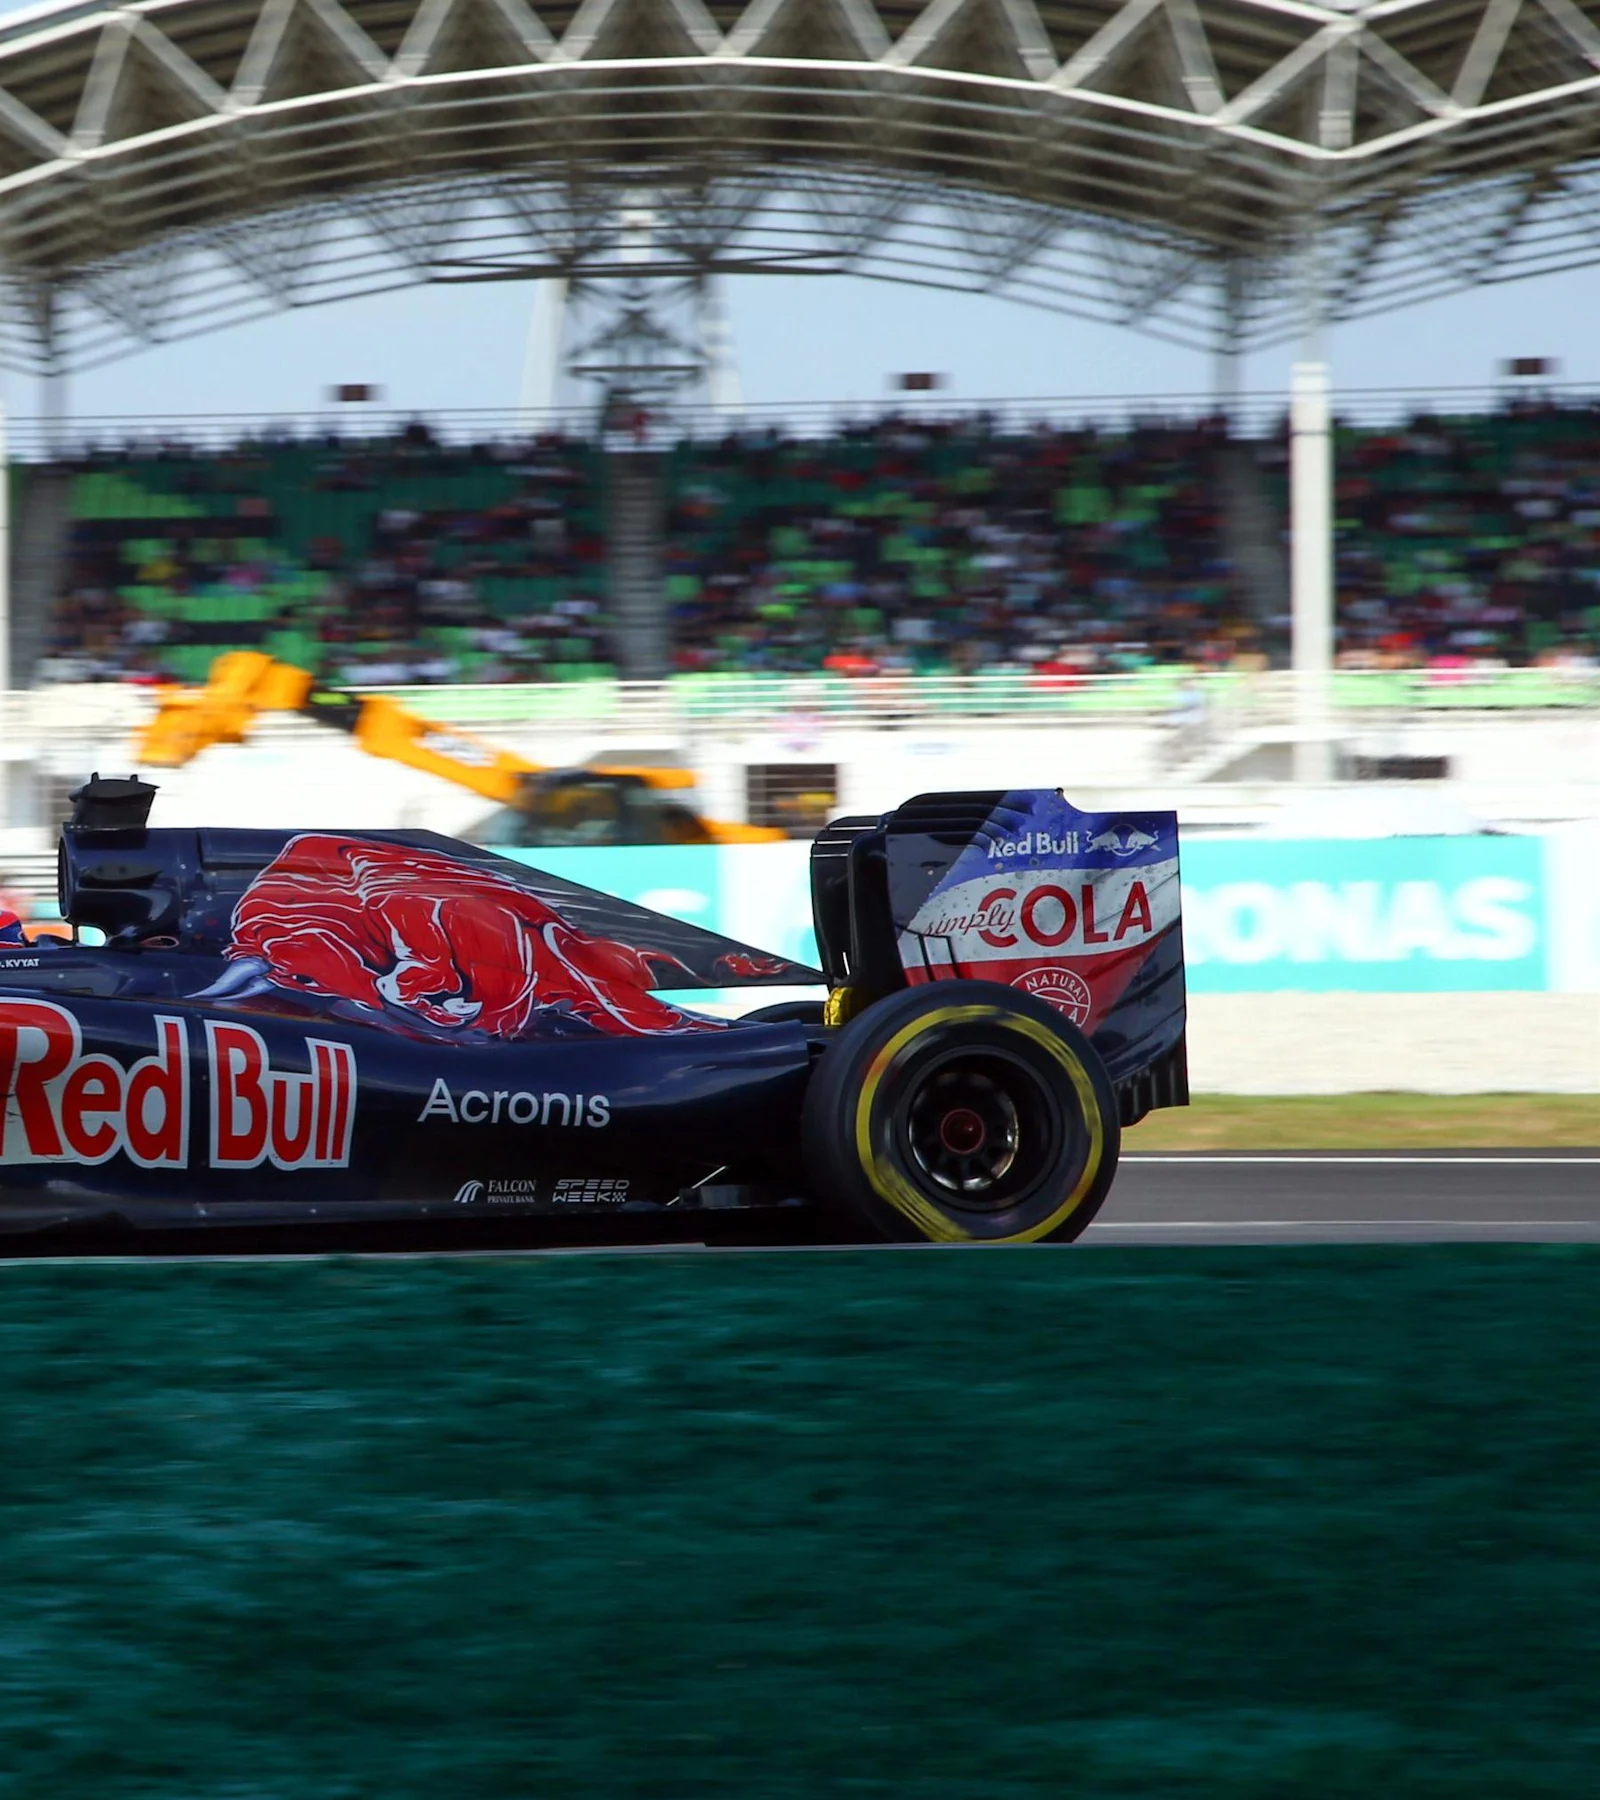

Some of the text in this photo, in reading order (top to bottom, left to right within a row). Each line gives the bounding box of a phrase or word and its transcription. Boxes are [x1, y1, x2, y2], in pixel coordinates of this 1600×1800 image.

[987, 831, 1079, 859] Red Bull
[923, 881, 1152, 948] simply COLA
[6, 958, 40, 968] KVYAT
[1025, 973, 1087, 1002] NATURAL
[203, 1018, 357, 1170] Bull
[418, 1078, 611, 1127] Acronis
[488, 1179, 536, 1192] FALCON
[555, 1179, 630, 1189] SPEED
